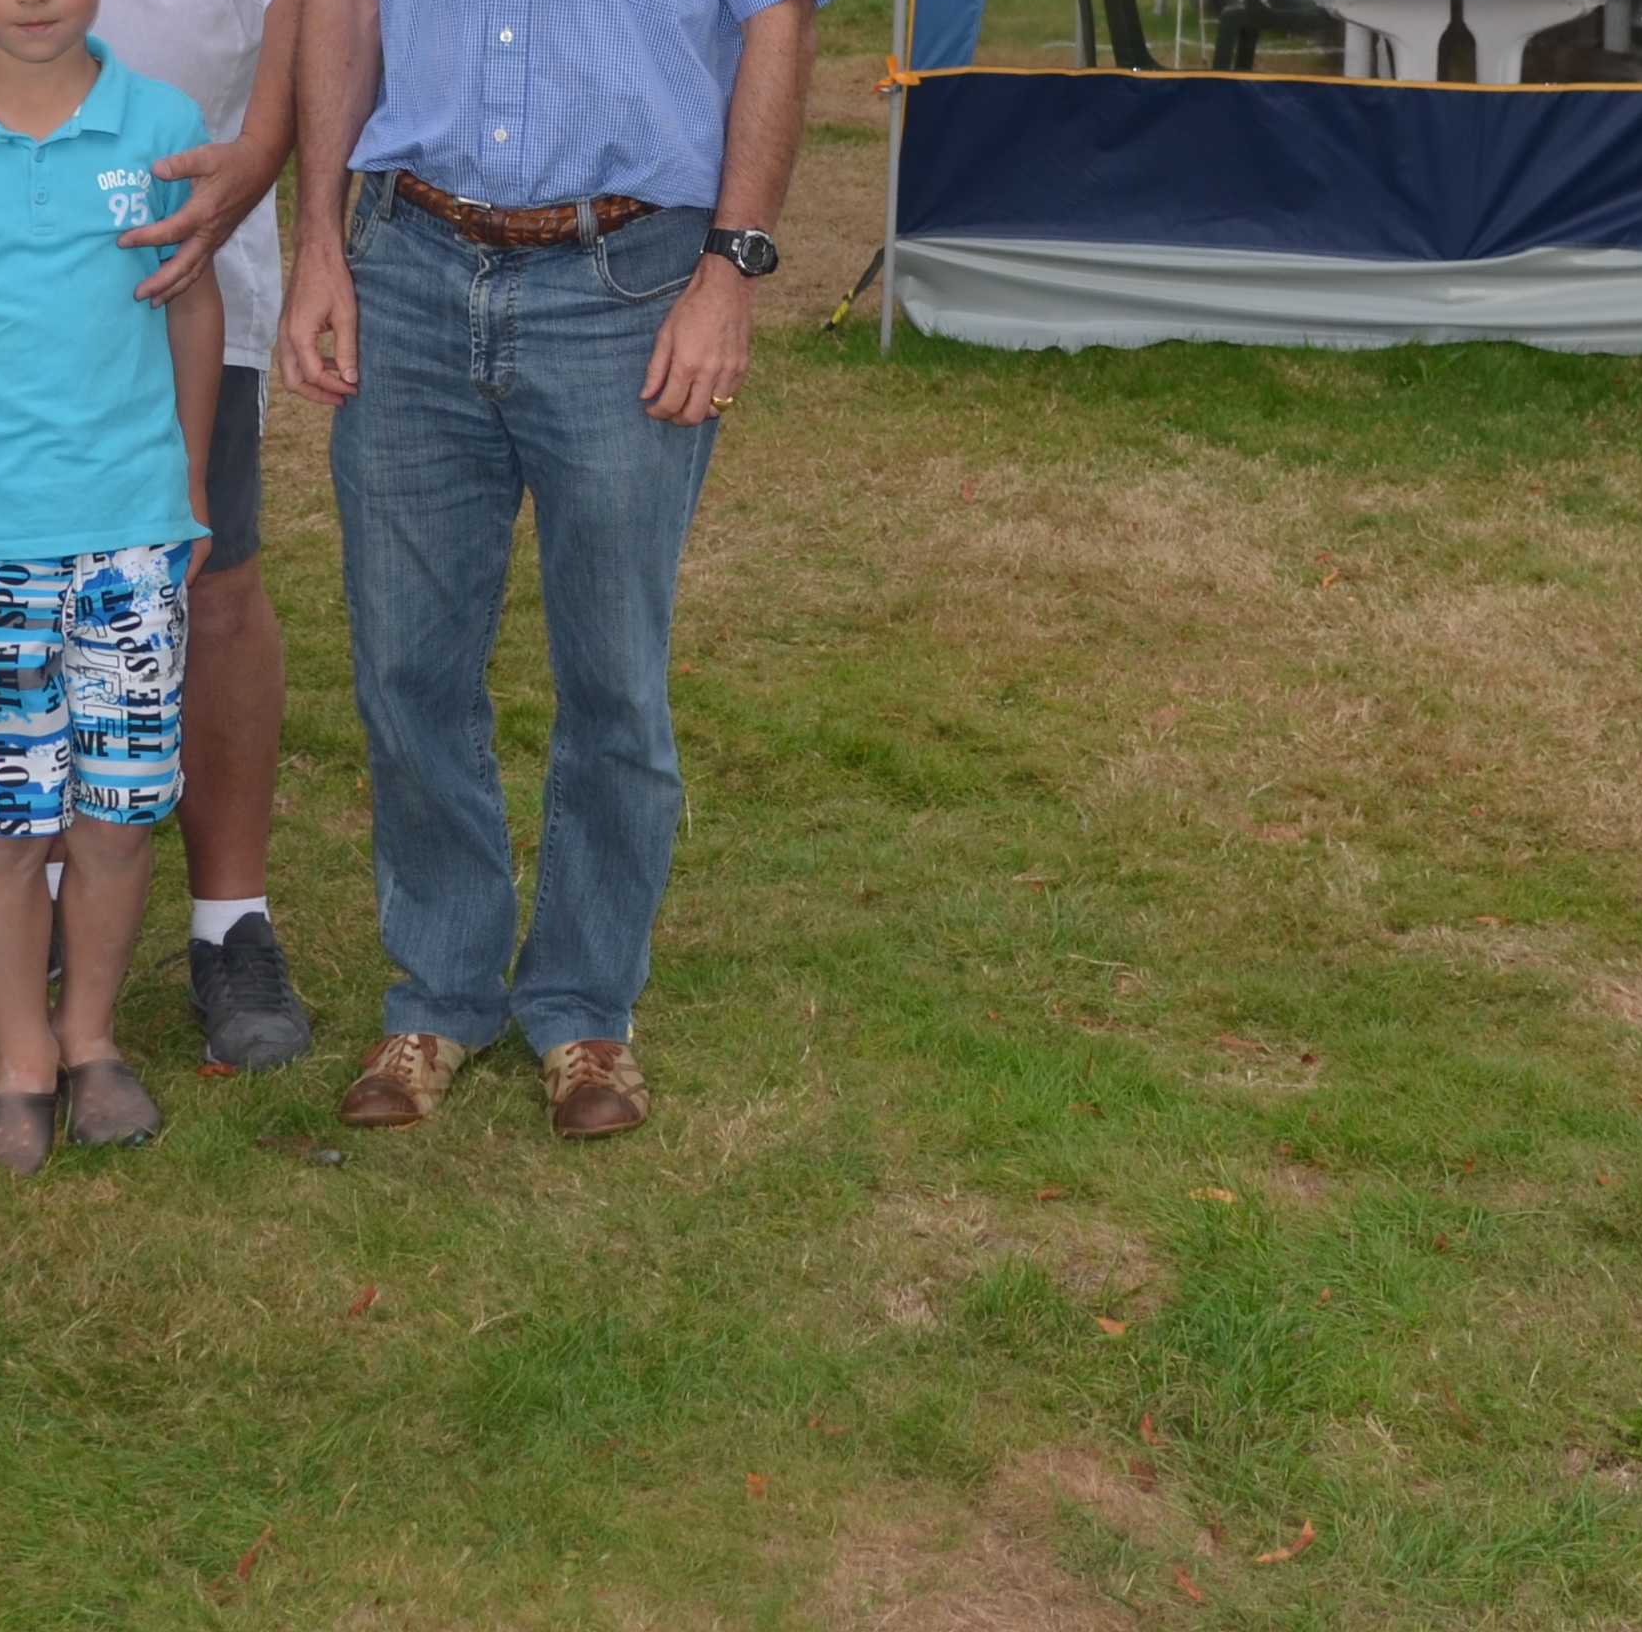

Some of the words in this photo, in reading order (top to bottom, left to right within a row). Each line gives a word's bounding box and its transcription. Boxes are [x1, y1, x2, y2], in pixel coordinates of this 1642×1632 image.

[109, 192, 148, 226] 95
[101, 588, 159, 674] SPOT
[126, 688, 163, 759] THE
